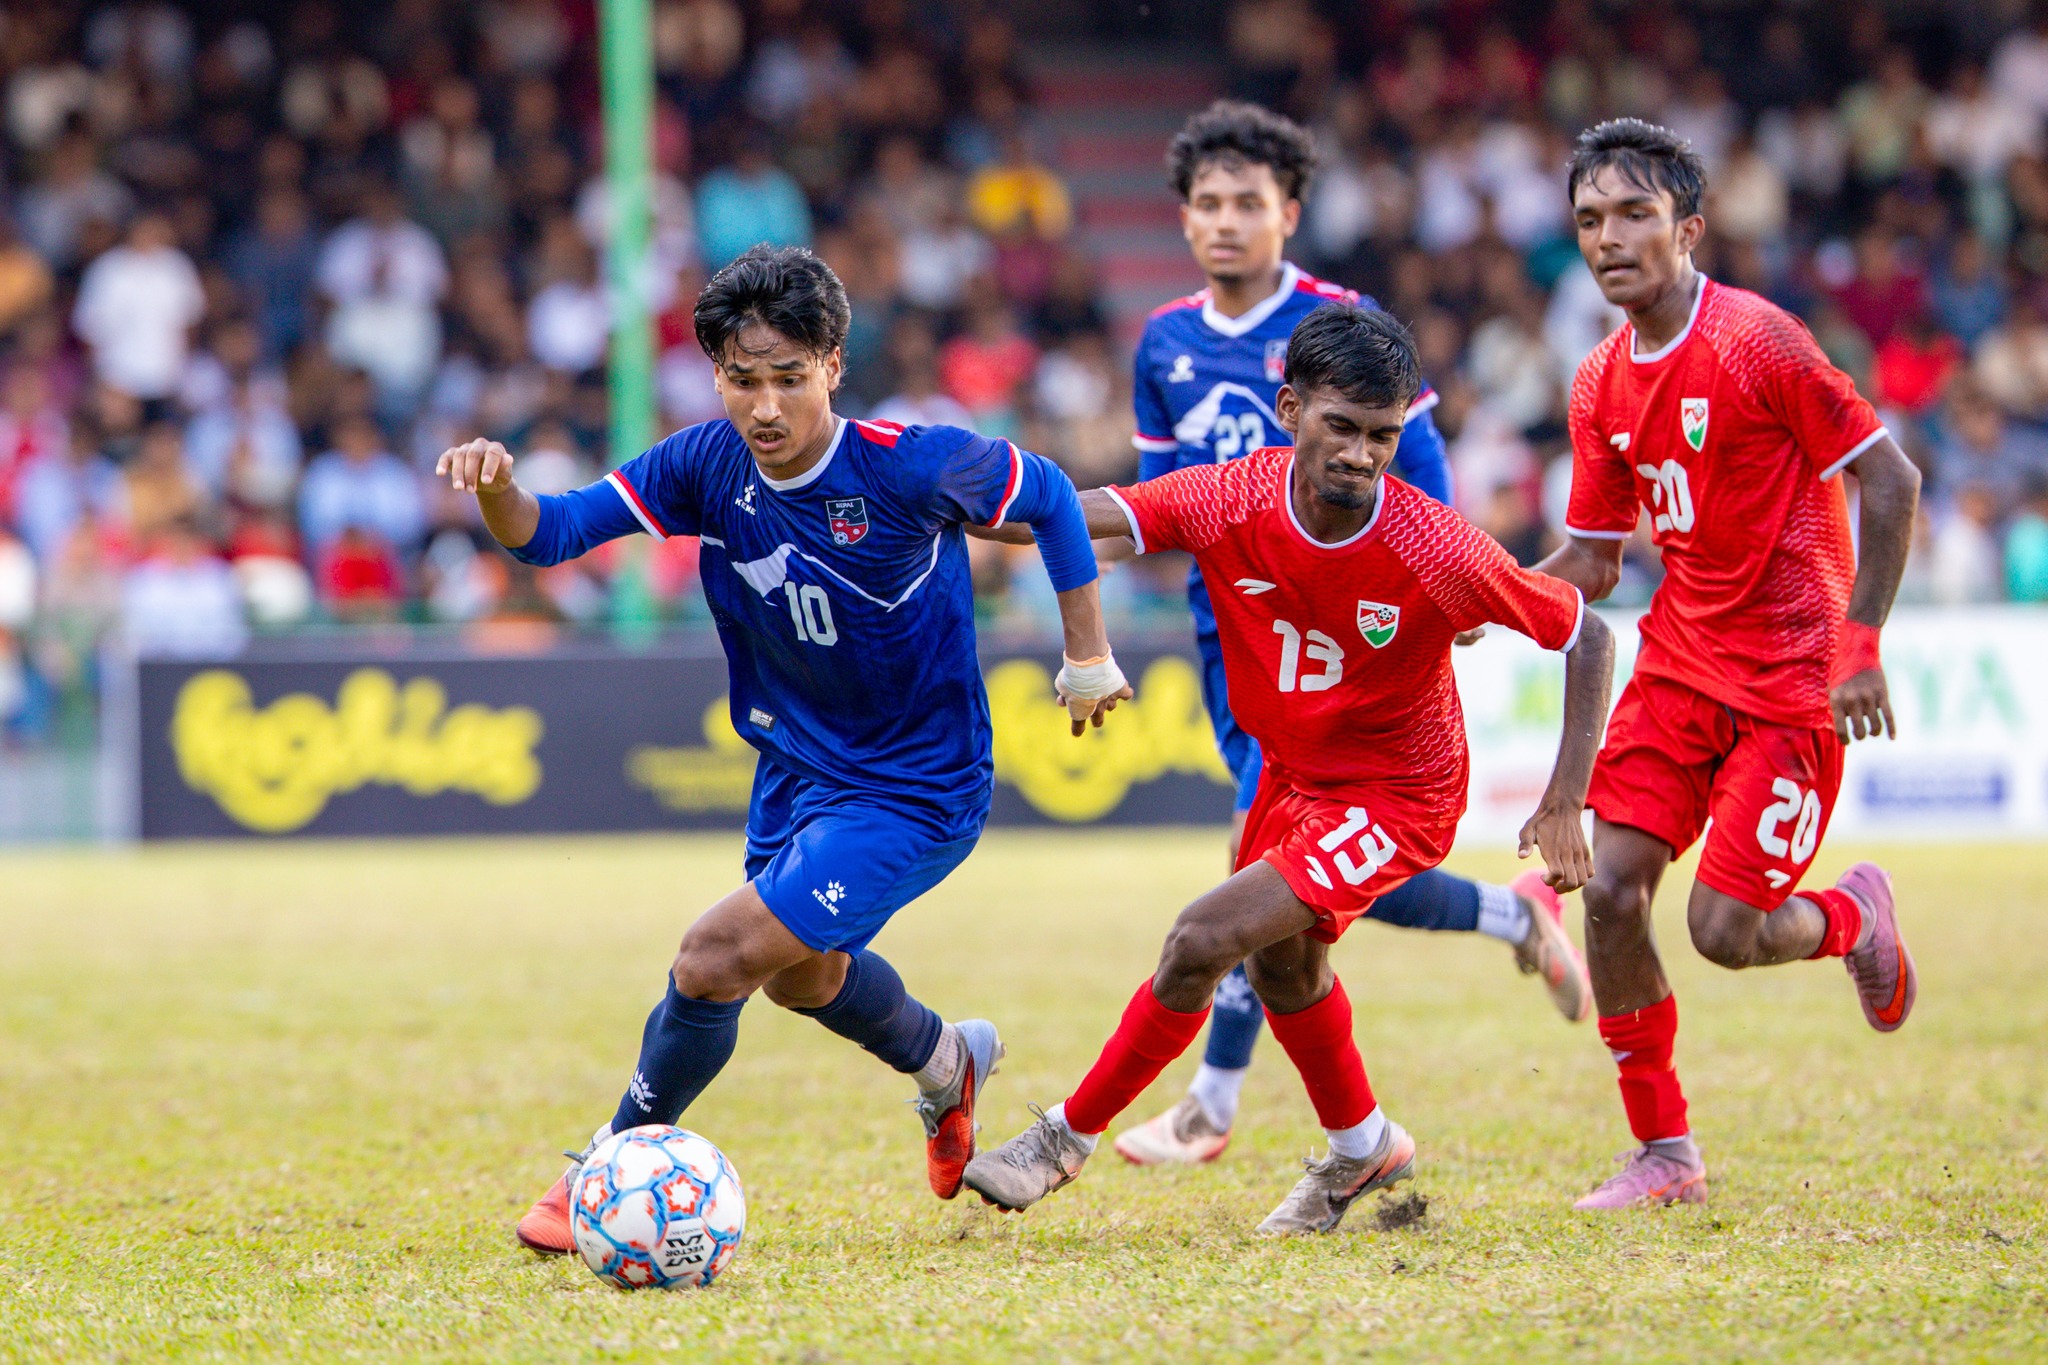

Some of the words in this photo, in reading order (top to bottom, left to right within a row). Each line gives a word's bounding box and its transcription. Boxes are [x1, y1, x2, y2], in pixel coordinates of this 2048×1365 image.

[1636, 458, 1696, 533] 20
[784, 580, 838, 647] 10
[1272, 619, 1345, 693] 13
[1317, 806, 1398, 886] 13
[1756, 776, 1822, 866] 20
[811, 888, 840, 917] KELME
[665, 1244, 705, 1257] VECTOR
